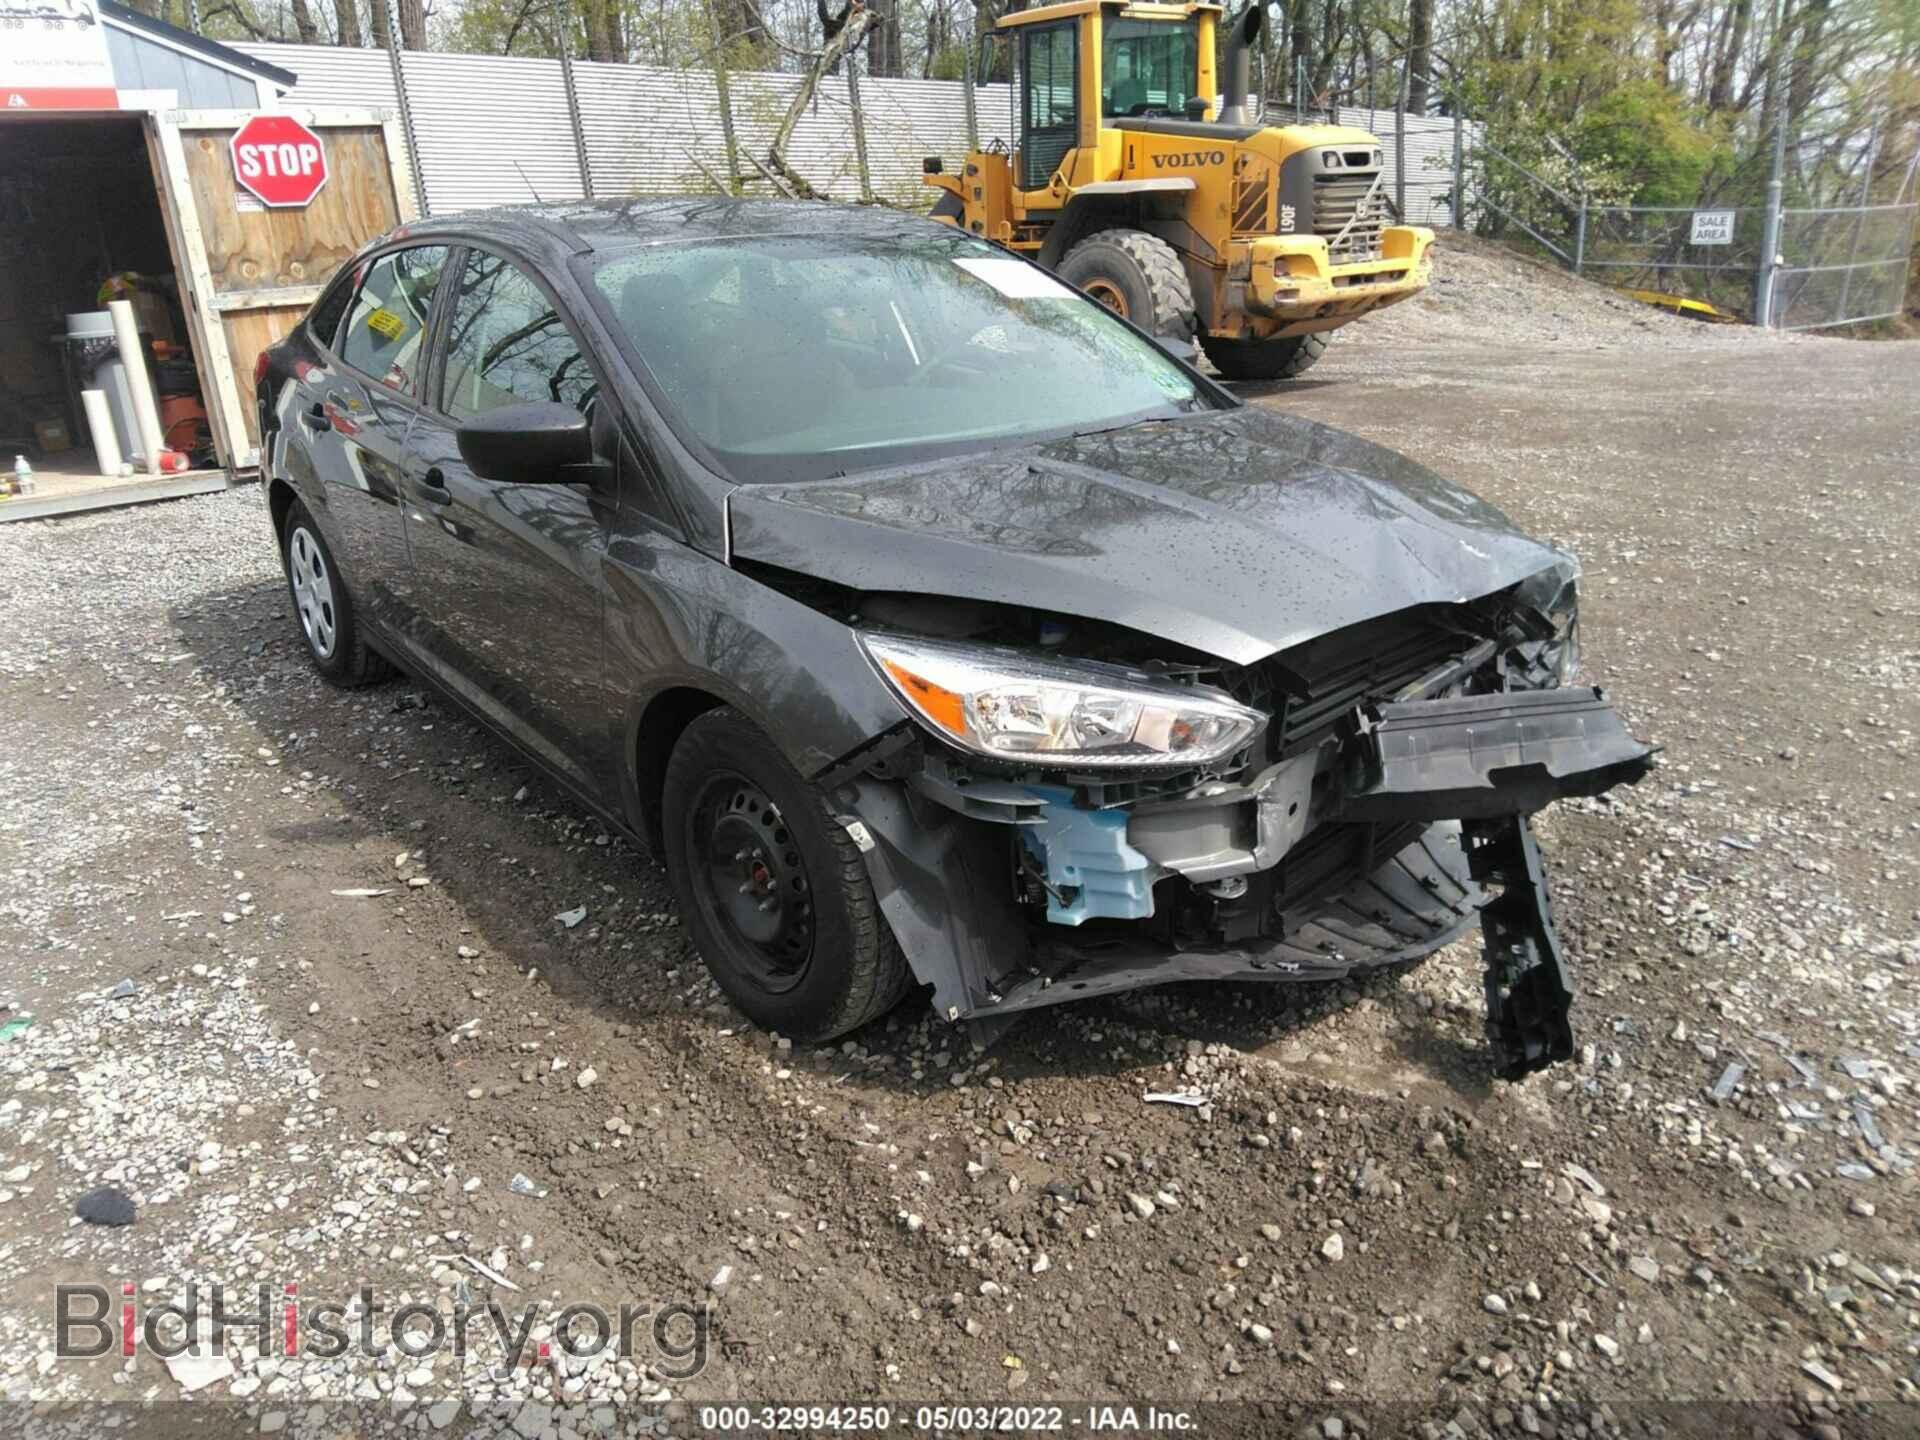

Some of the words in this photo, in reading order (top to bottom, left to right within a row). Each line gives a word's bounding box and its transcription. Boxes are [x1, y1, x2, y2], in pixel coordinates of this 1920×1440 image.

[239, 143, 319, 177] STOP
[1152, 150, 1225, 168] VOLVO
[1280, 203, 1296, 232] L90F
[1698, 216, 1729, 227] SALE
[1696, 229, 1727, 240] AREA
